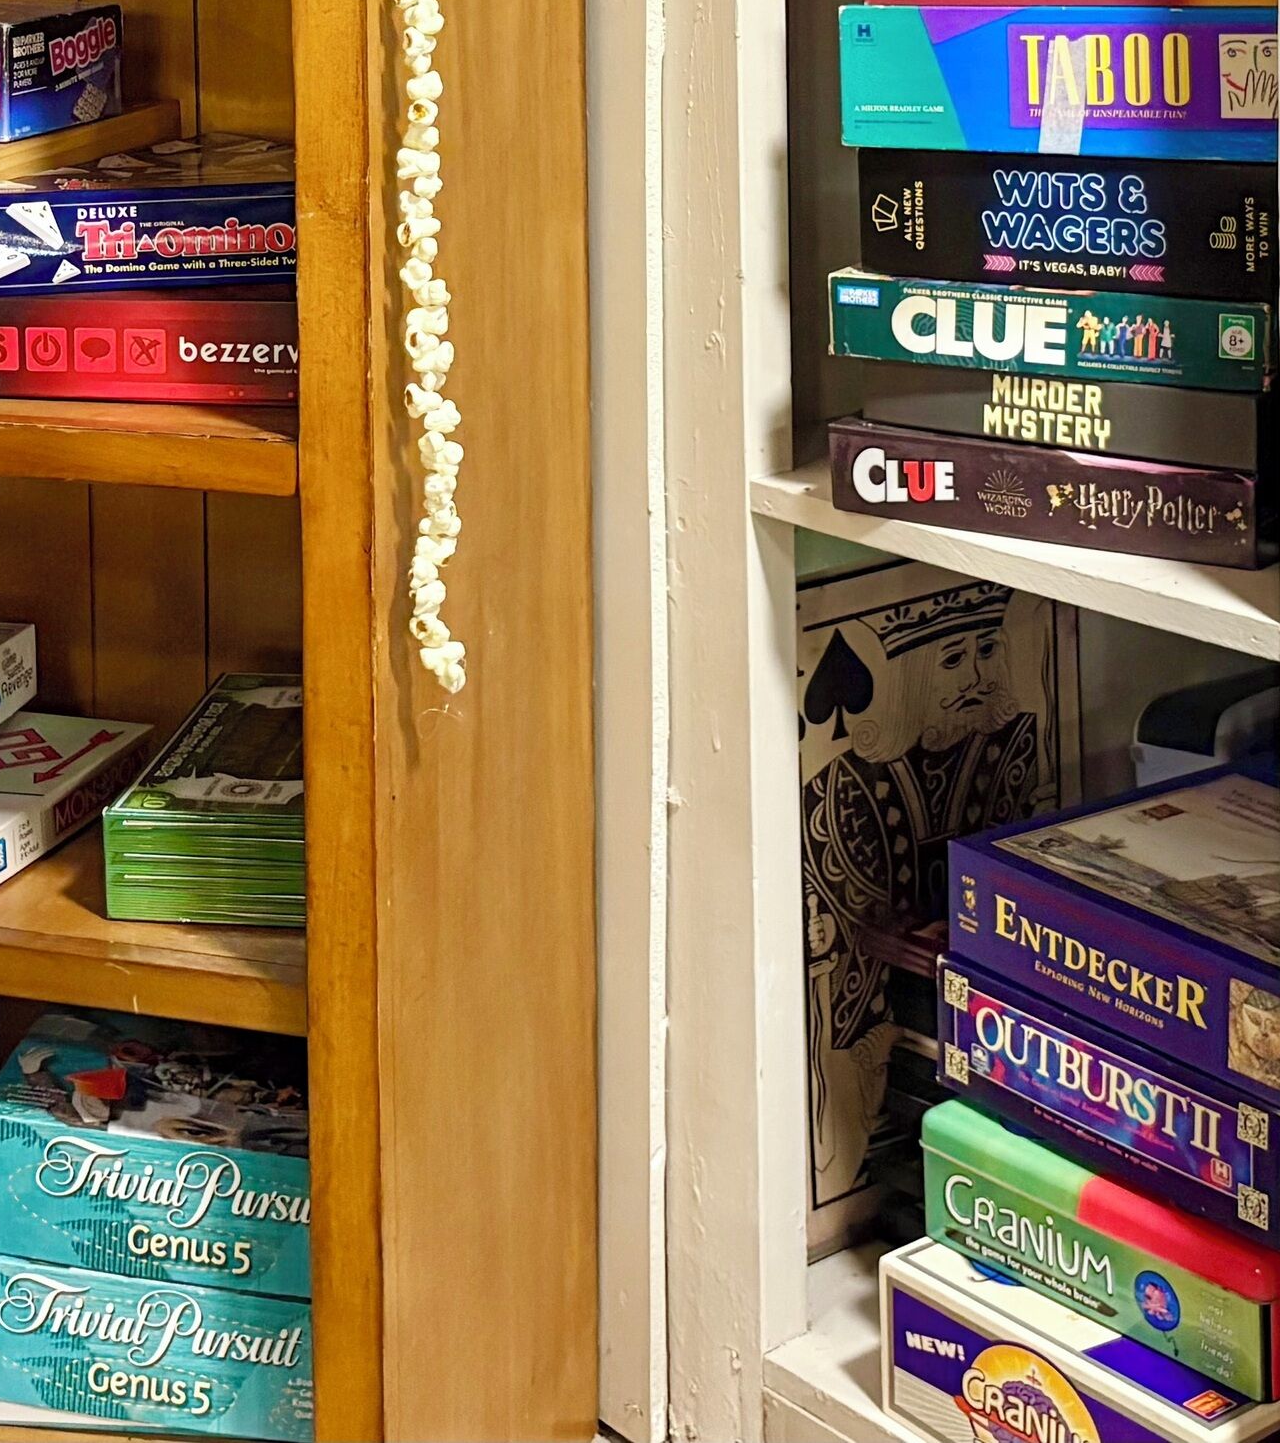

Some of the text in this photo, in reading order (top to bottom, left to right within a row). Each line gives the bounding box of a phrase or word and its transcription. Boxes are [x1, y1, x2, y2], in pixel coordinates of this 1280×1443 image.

[1020, 33, 1191, 106] TABOO
[993, 170, 1147, 213] WITS &
[982, 211, 1165, 257] WAGERS
[1018, 261, 1126, 278] IT'S VEGAS, BABY!
[892, 295, 1068, 365] CLUE
[993, 374, 1102, 415] MURDER
[983, 404, 1111, 449] MYSTERY
[853, 448, 956, 503] CLUE
[1074, 482, 1222, 534] Harry Potter
[994, 894, 1207, 1029] ENTDECKER
[976, 1007, 1187, 1137] OUTBURST
[1190, 1102, 1221, 1156] II
[129, 1289, 302, 1367] Pursuit
[905, 1331, 964, 1360] NEW!
[88, 1363, 211, 1413] Genus 5
